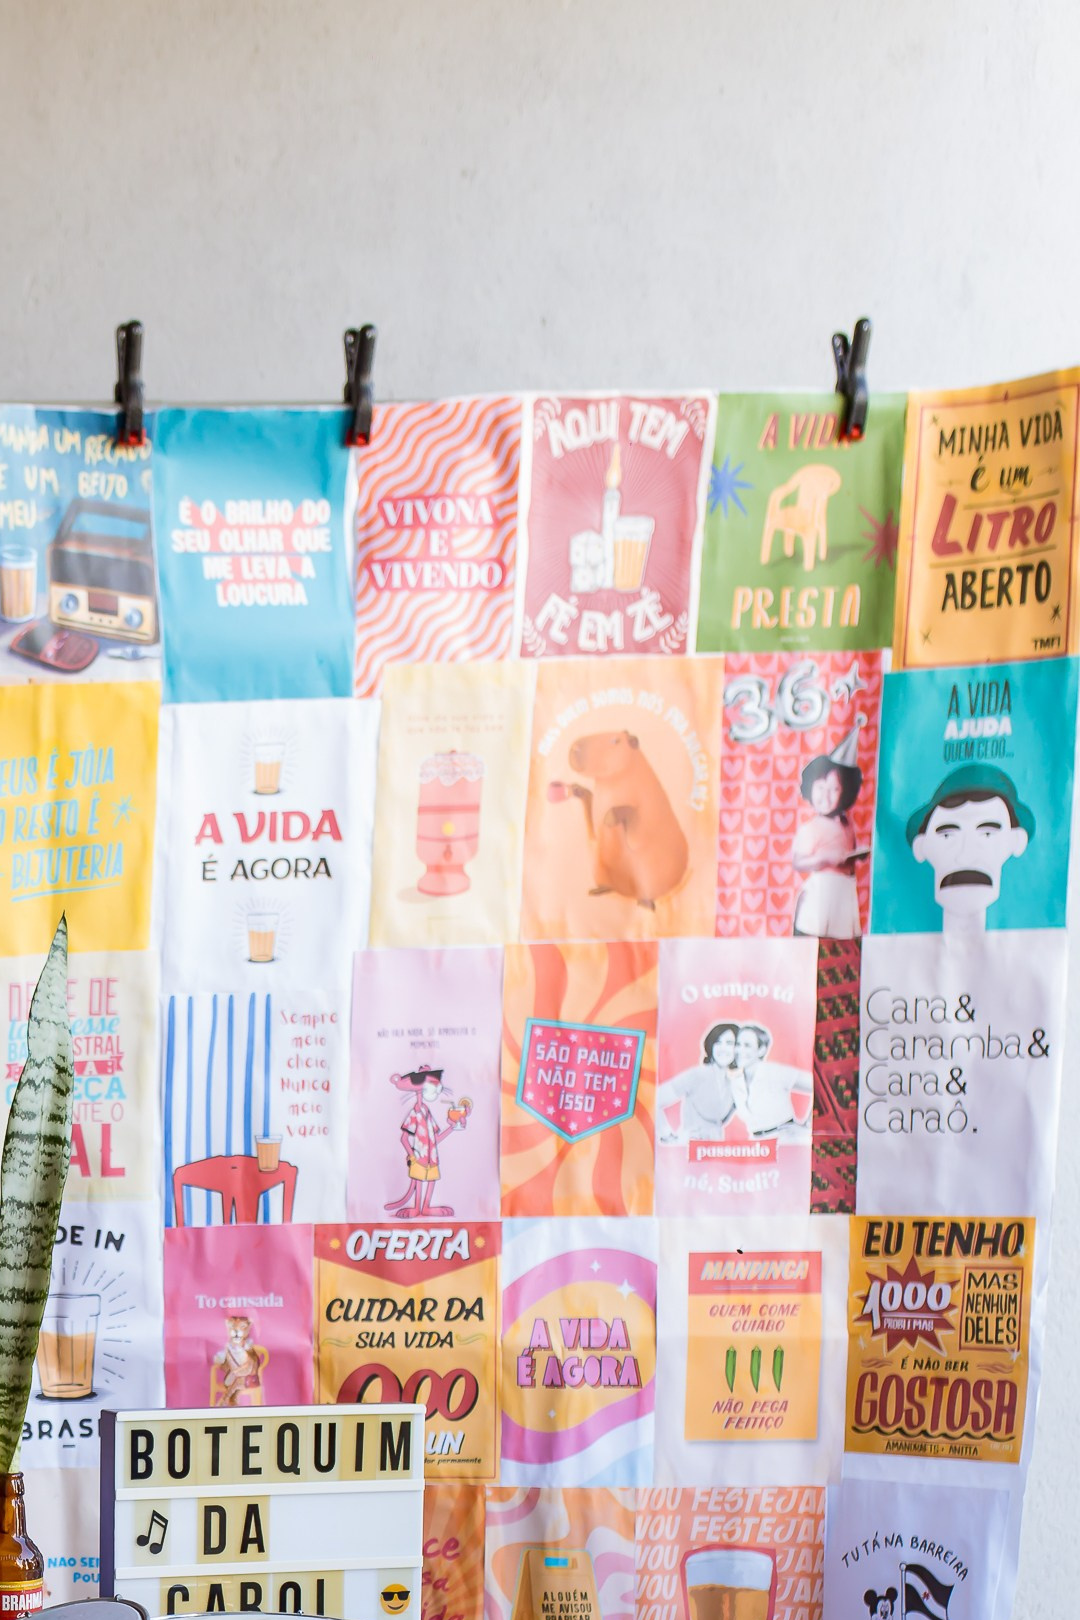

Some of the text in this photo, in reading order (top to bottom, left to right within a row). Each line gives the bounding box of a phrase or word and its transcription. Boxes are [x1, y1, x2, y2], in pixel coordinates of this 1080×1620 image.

[939, 410, 1063, 457] MINHA VIDA
[382, 498, 492, 526] VIVONA
[932, 496, 1056, 556] LITRO
[430, 531, 447, 556] E
[370, 562, 503, 589] VIVENDO
[941, 560, 1051, 612] ABERTO
[195, 810, 342, 845] A VIDA
[202, 855, 331, 881] É AGORA
[536, 1041, 631, 1070] SÃO PAULO
[537, 1068, 617, 1091] NÃO TEM
[346, 1229, 470, 1262] OFERTA
[864, 1221, 1025, 1257] EU TENHO
[967, 1272, 1017, 1291] MAS
[326, 1297, 485, 1323] CUIDAR DA
[865, 1281, 952, 1333] 1000
[967, 1293, 1017, 1315] NENHUM
[355, 1330, 454, 1349] SUA VIDA
[964, 1318, 1017, 1346] DELES
[853, 1373, 1016, 1435] GOSTOSA
[130, 1421, 411, 1479] BOTEQUIM
[202, 1504, 266, 1554] DA
[910, 1534, 969, 1582] BARREIRA
[542, 1604, 591, 1613] ME AVISOU
